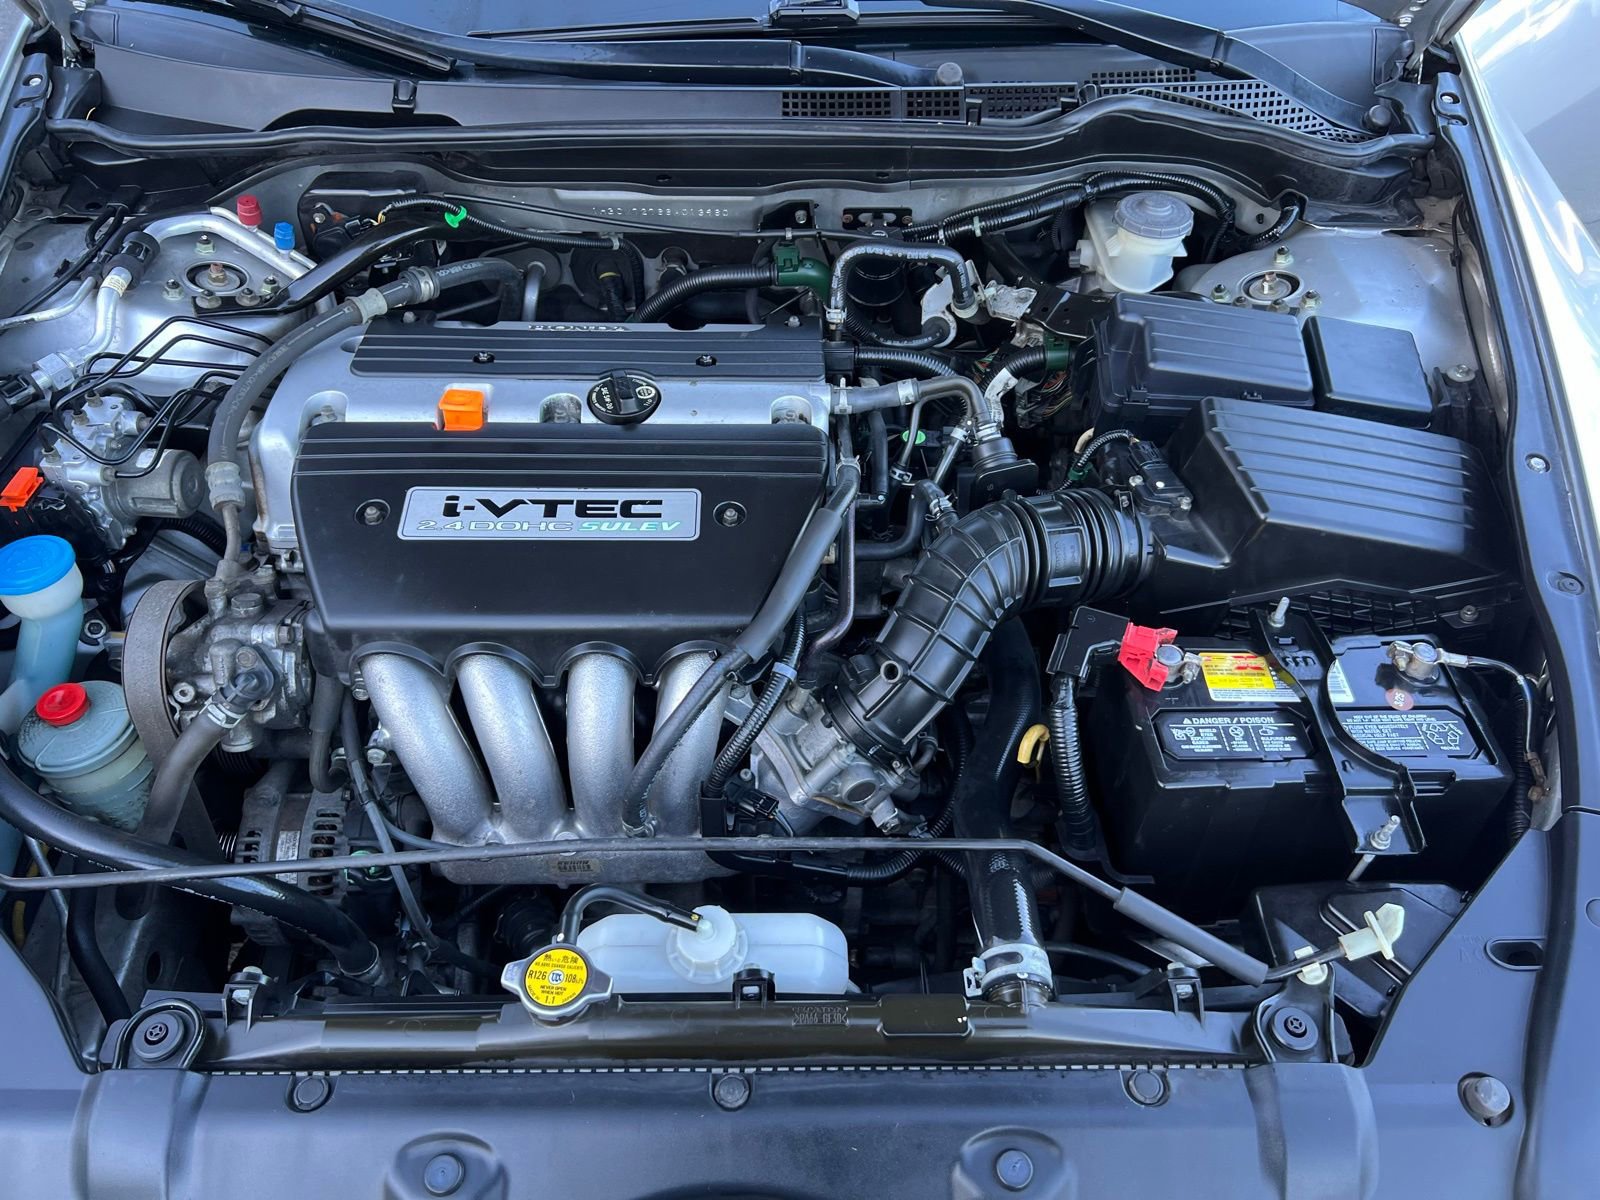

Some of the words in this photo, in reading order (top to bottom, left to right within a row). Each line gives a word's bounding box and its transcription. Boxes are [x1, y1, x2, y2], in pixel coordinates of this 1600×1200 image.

[442, 495, 663, 519] i-VTEC
[417, 520, 465, 531] 2.4
[468, 520, 573, 532] DOHC
[577, 520, 681, 532] SULEV
[1192, 717, 1231, 725] DANGER
[528, 970, 547, 980] R126
